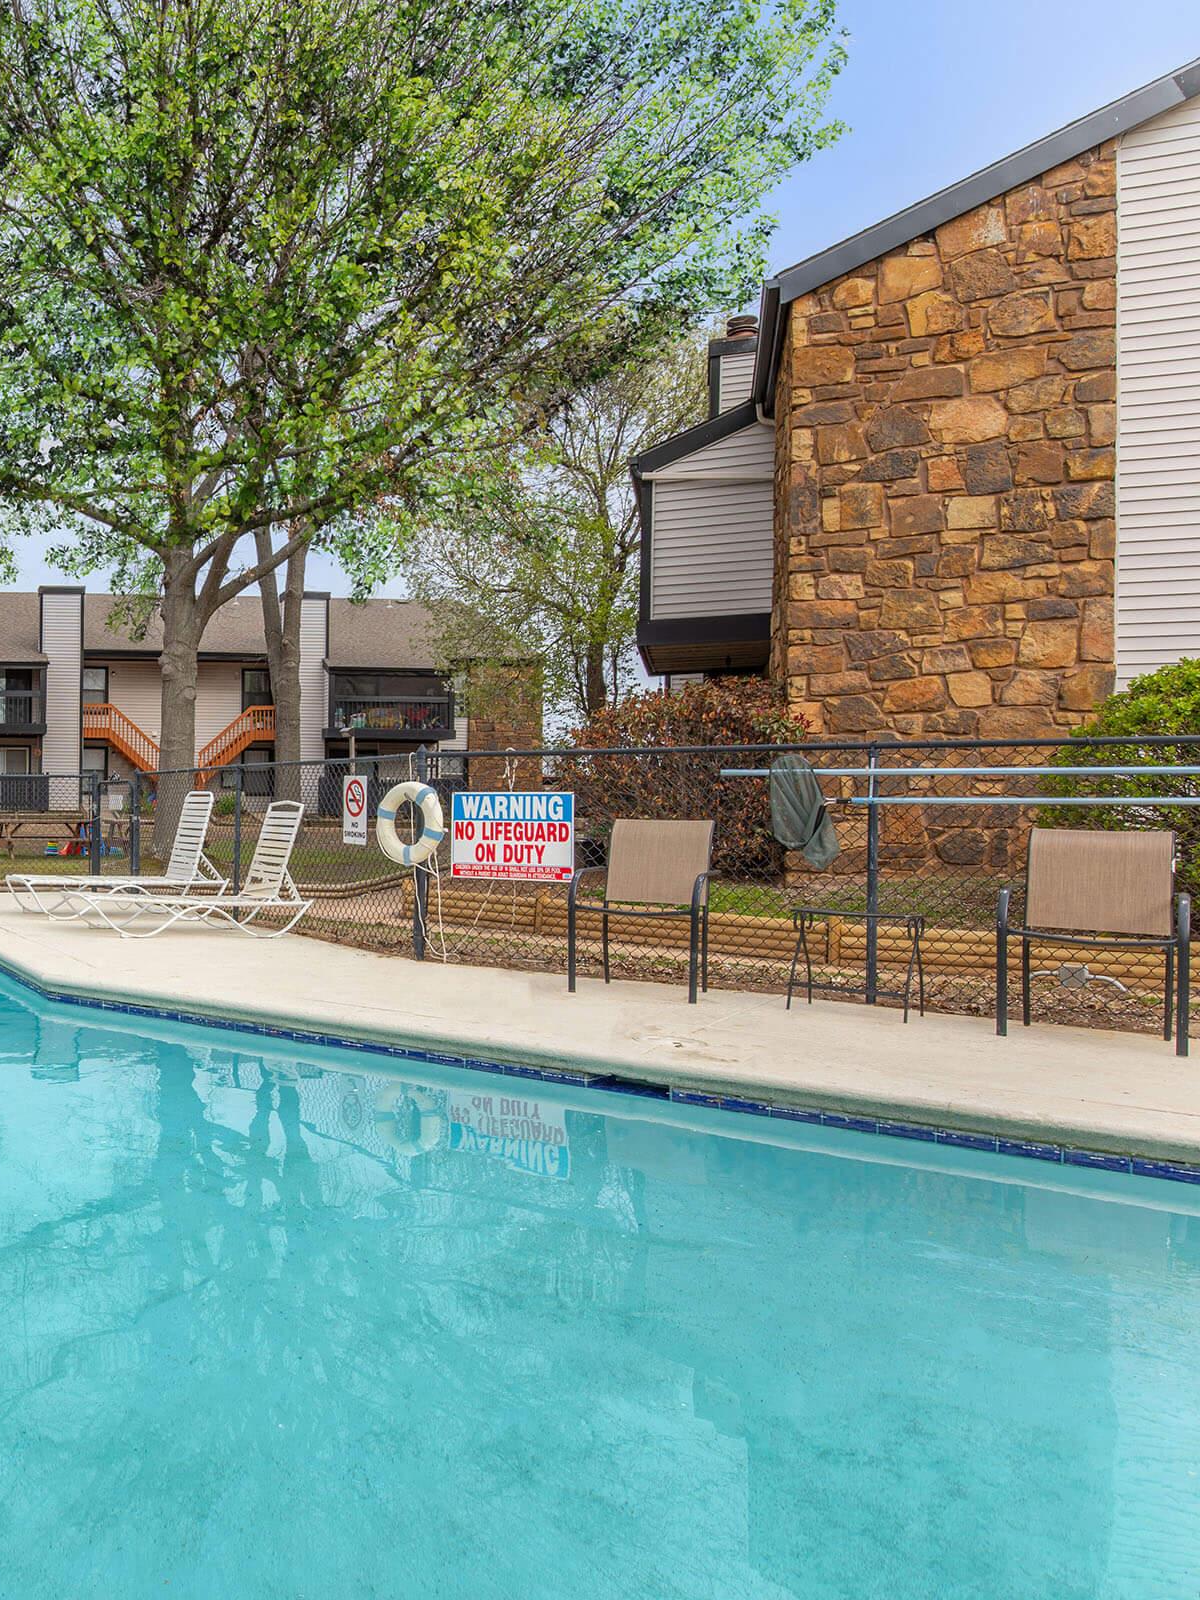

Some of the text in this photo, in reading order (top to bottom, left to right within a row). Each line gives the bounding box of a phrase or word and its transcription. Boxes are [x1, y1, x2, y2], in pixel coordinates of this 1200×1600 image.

[461, 796, 564, 820] WARNING
[344, 830, 366, 839] SMOKING
[455, 821, 570, 842] NO LIFEGUARD
[475, 843, 546, 864] ON DUTY
